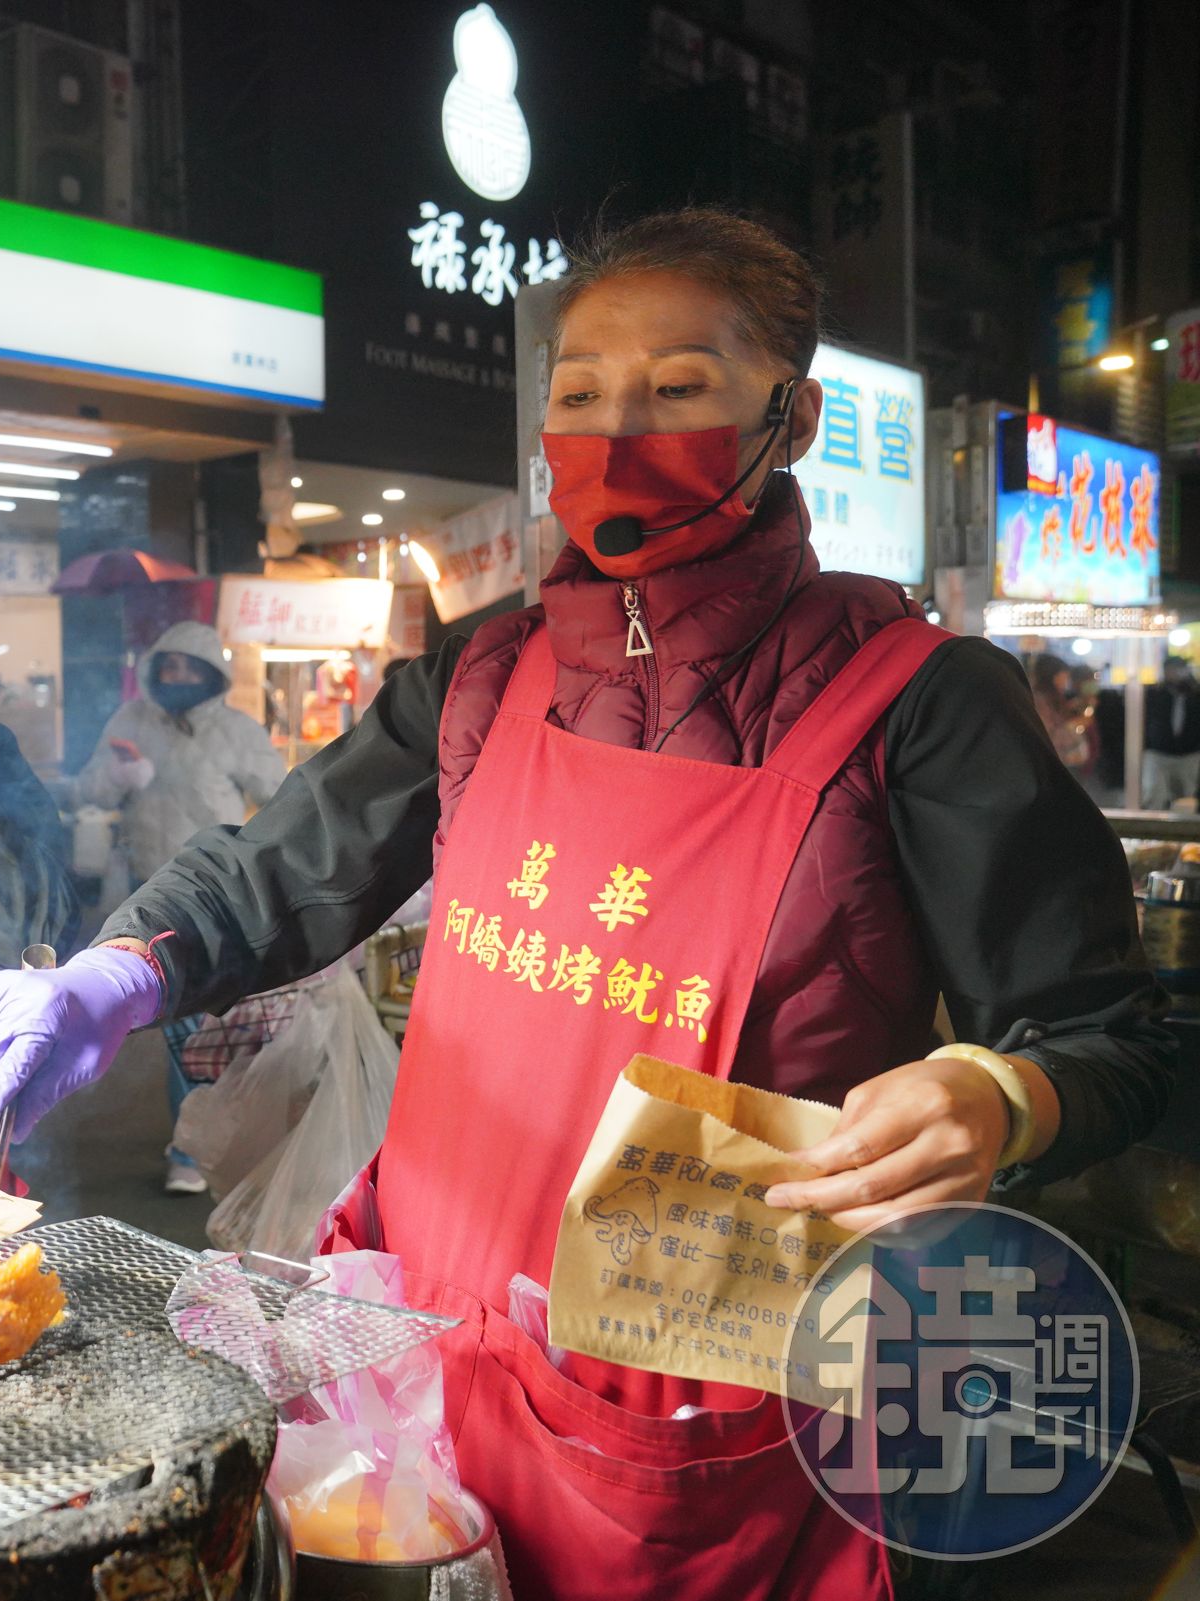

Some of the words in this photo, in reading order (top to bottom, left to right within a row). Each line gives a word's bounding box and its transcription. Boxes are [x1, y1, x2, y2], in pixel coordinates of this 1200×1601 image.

[819, 375, 915, 482] 直營
[506, 839, 657, 932] 萬華
[443, 898, 712, 1043] 阿嬌姨烤魷魚
